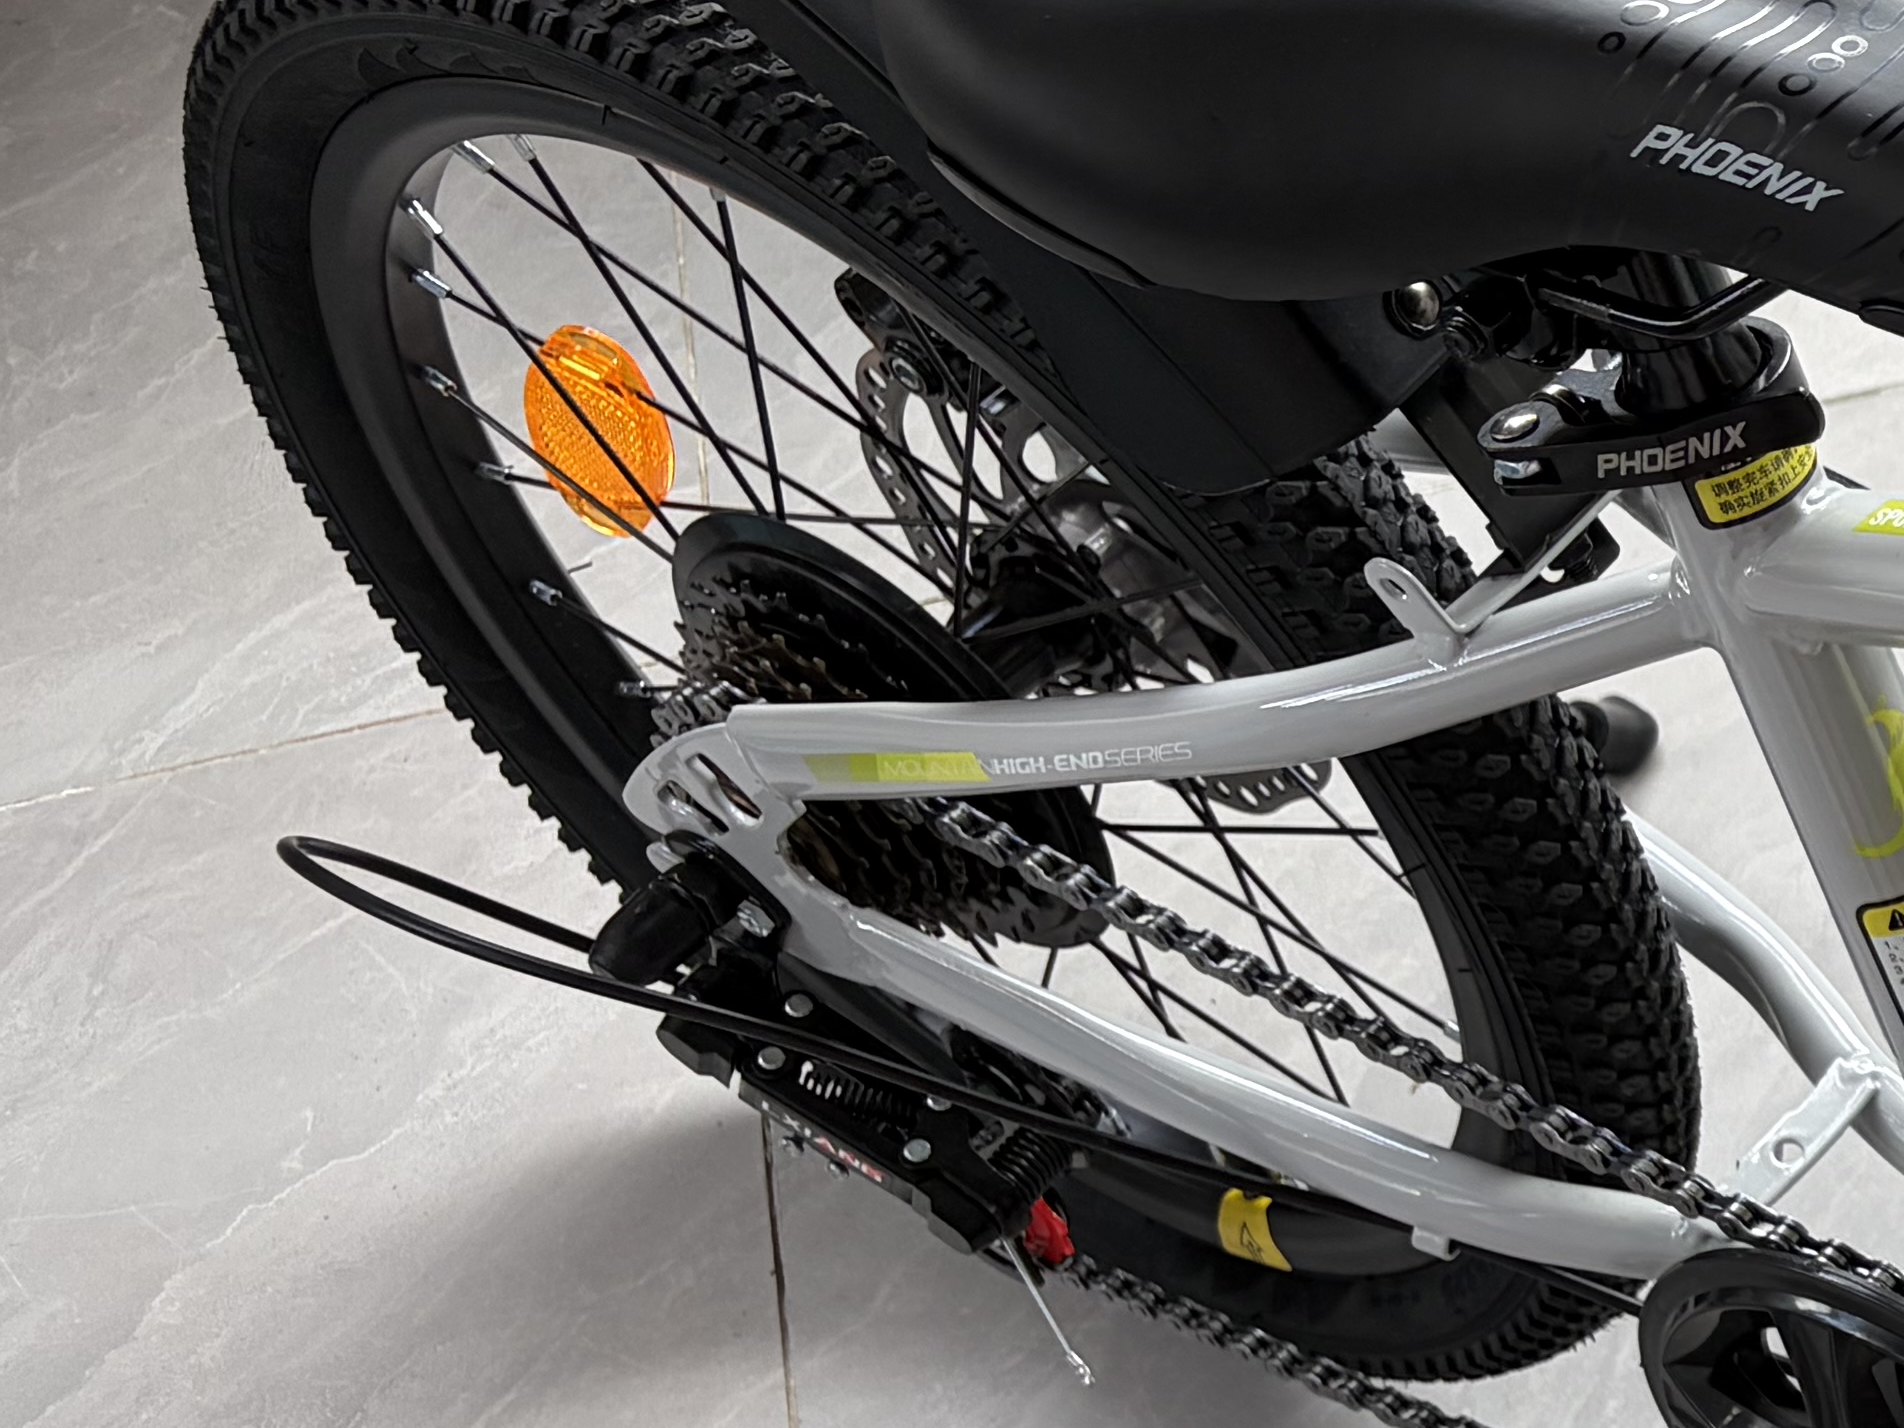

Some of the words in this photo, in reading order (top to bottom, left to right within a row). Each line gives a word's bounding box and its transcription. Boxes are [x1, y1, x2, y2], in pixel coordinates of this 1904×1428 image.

[1629, 124, 1845, 213] PHOENIX
[1596, 420, 1748, 479] PHOENIX
[995, 751, 1103, 775] HIGH-END
[1104, 740, 1193, 768] SERIES
